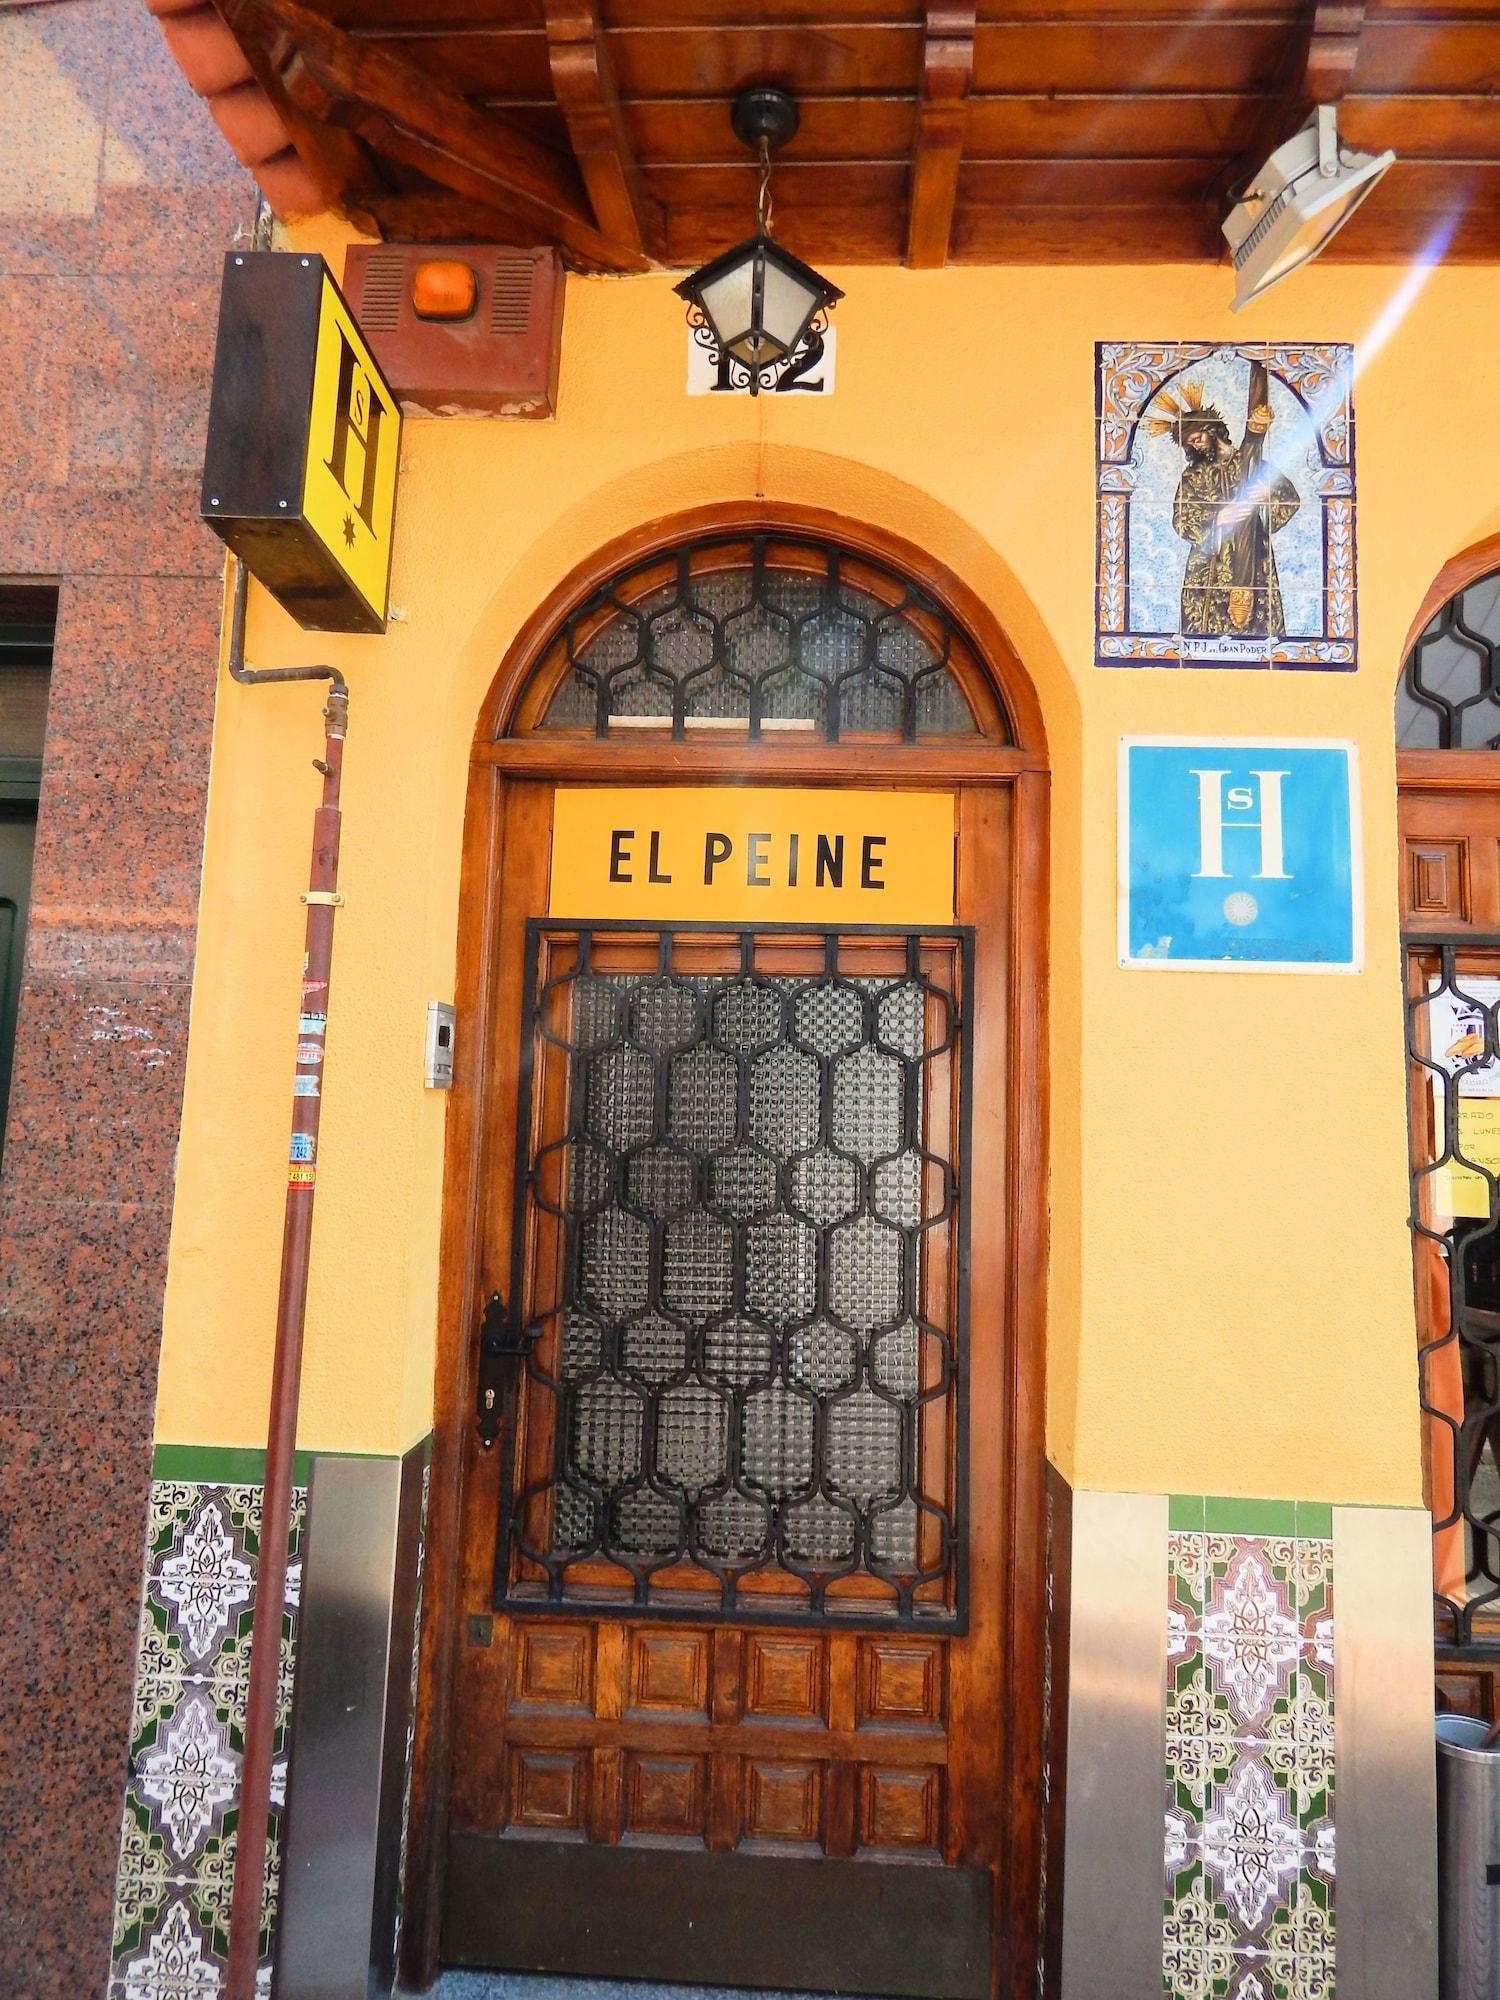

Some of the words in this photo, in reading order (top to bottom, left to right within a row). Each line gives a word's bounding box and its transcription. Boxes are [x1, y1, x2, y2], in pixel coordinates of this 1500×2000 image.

[1239, 643, 1267, 655] PODER
[1189, 769, 1294, 879] H
[610, 830, 672, 883] EL
[704, 832, 886, 890] PEINE
